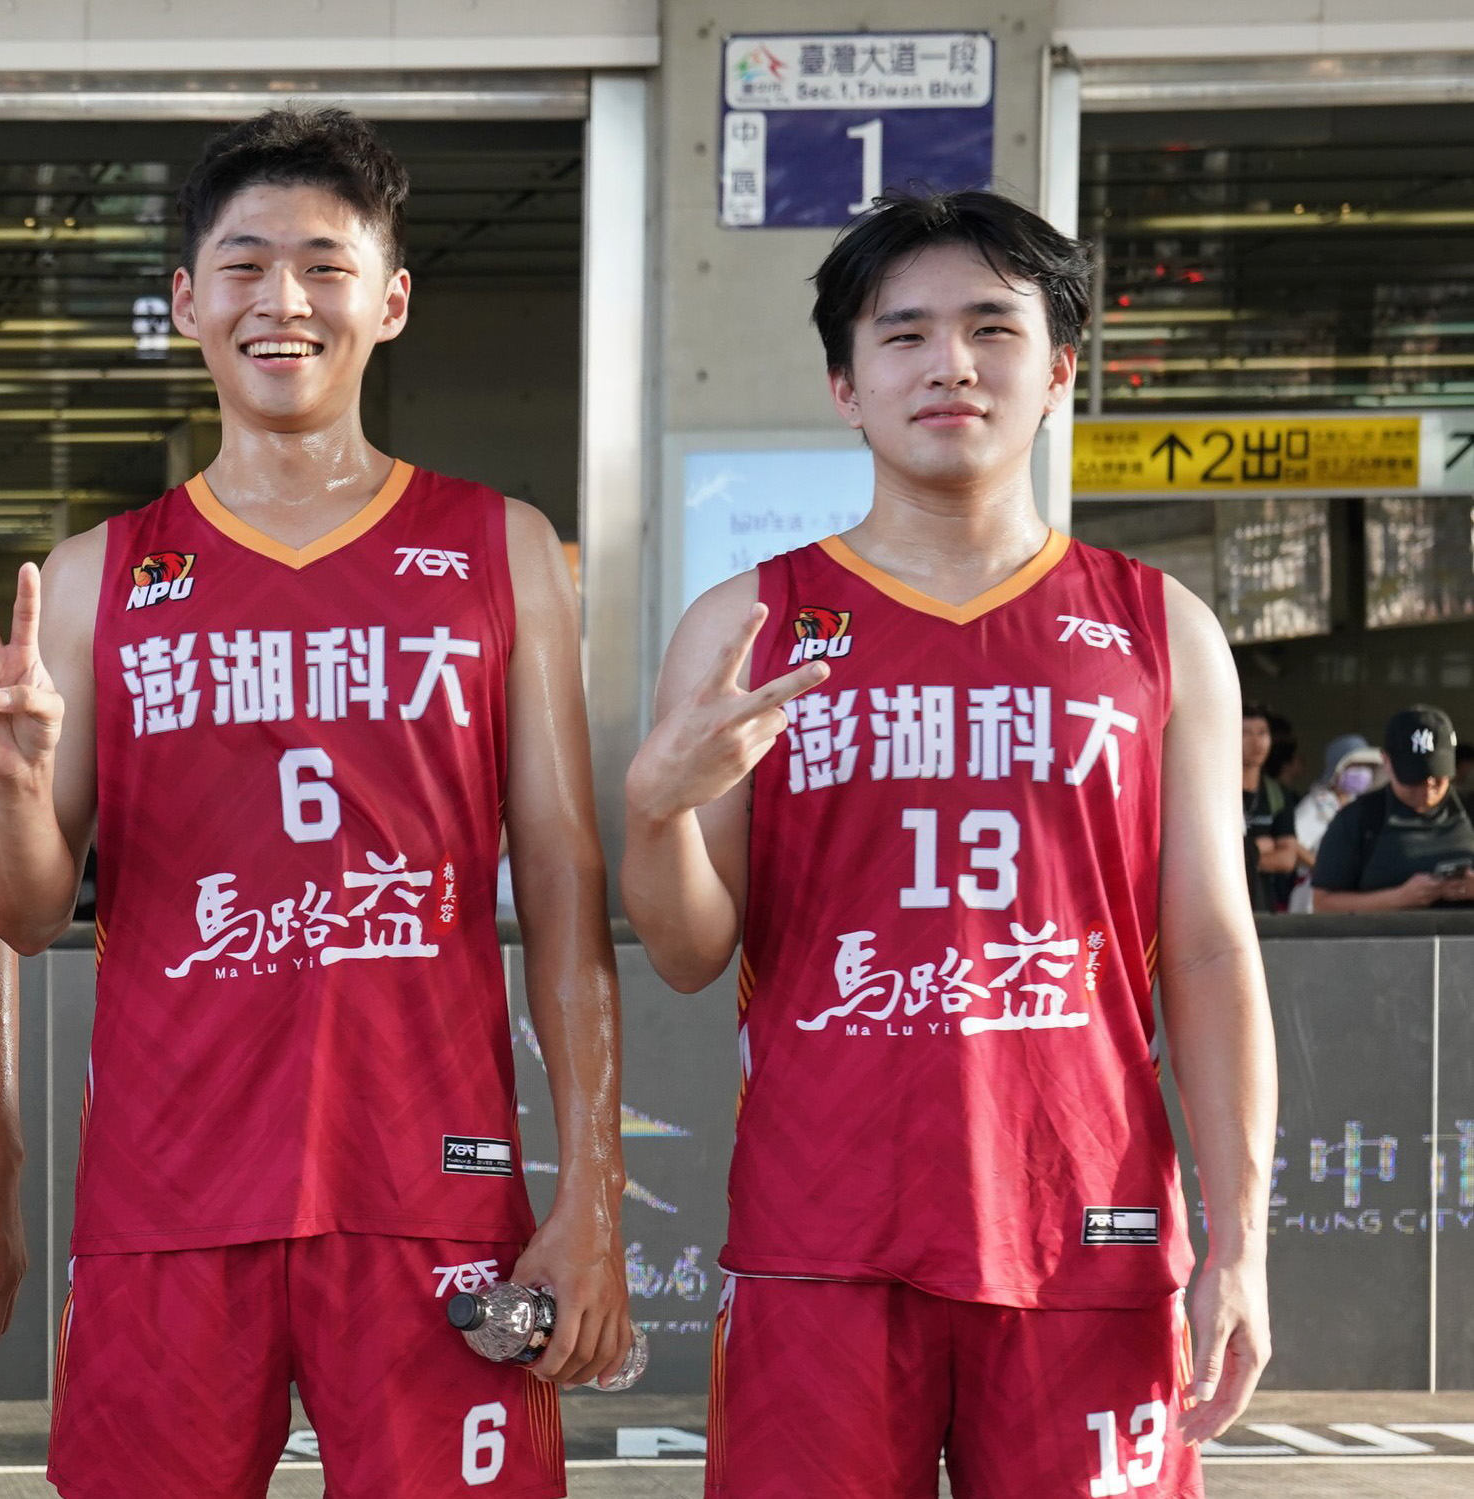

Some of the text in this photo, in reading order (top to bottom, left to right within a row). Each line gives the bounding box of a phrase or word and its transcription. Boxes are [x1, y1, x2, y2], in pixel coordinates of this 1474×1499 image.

[798, 42, 979, 76] 臺灣大道一段
[846, 118, 883, 215] 1
[126, 577, 194, 611] NPU
[118, 625, 480, 739] 澎湖科大
[784, 684, 1138, 799] 澎湖科大
[278, 747, 342, 844] 6
[899, 808, 1021, 911] 13
[164, 850, 439, 979] 馬路益
[215, 957, 315, 980] Ma Lu Yi
[795, 920, 1090, 1037] 馬路益
[845, 1022, 950, 1037] Ma Lu Yi
[461, 1401, 507, 1486] 6
[1086, 1399, 1167, 1498] 13
